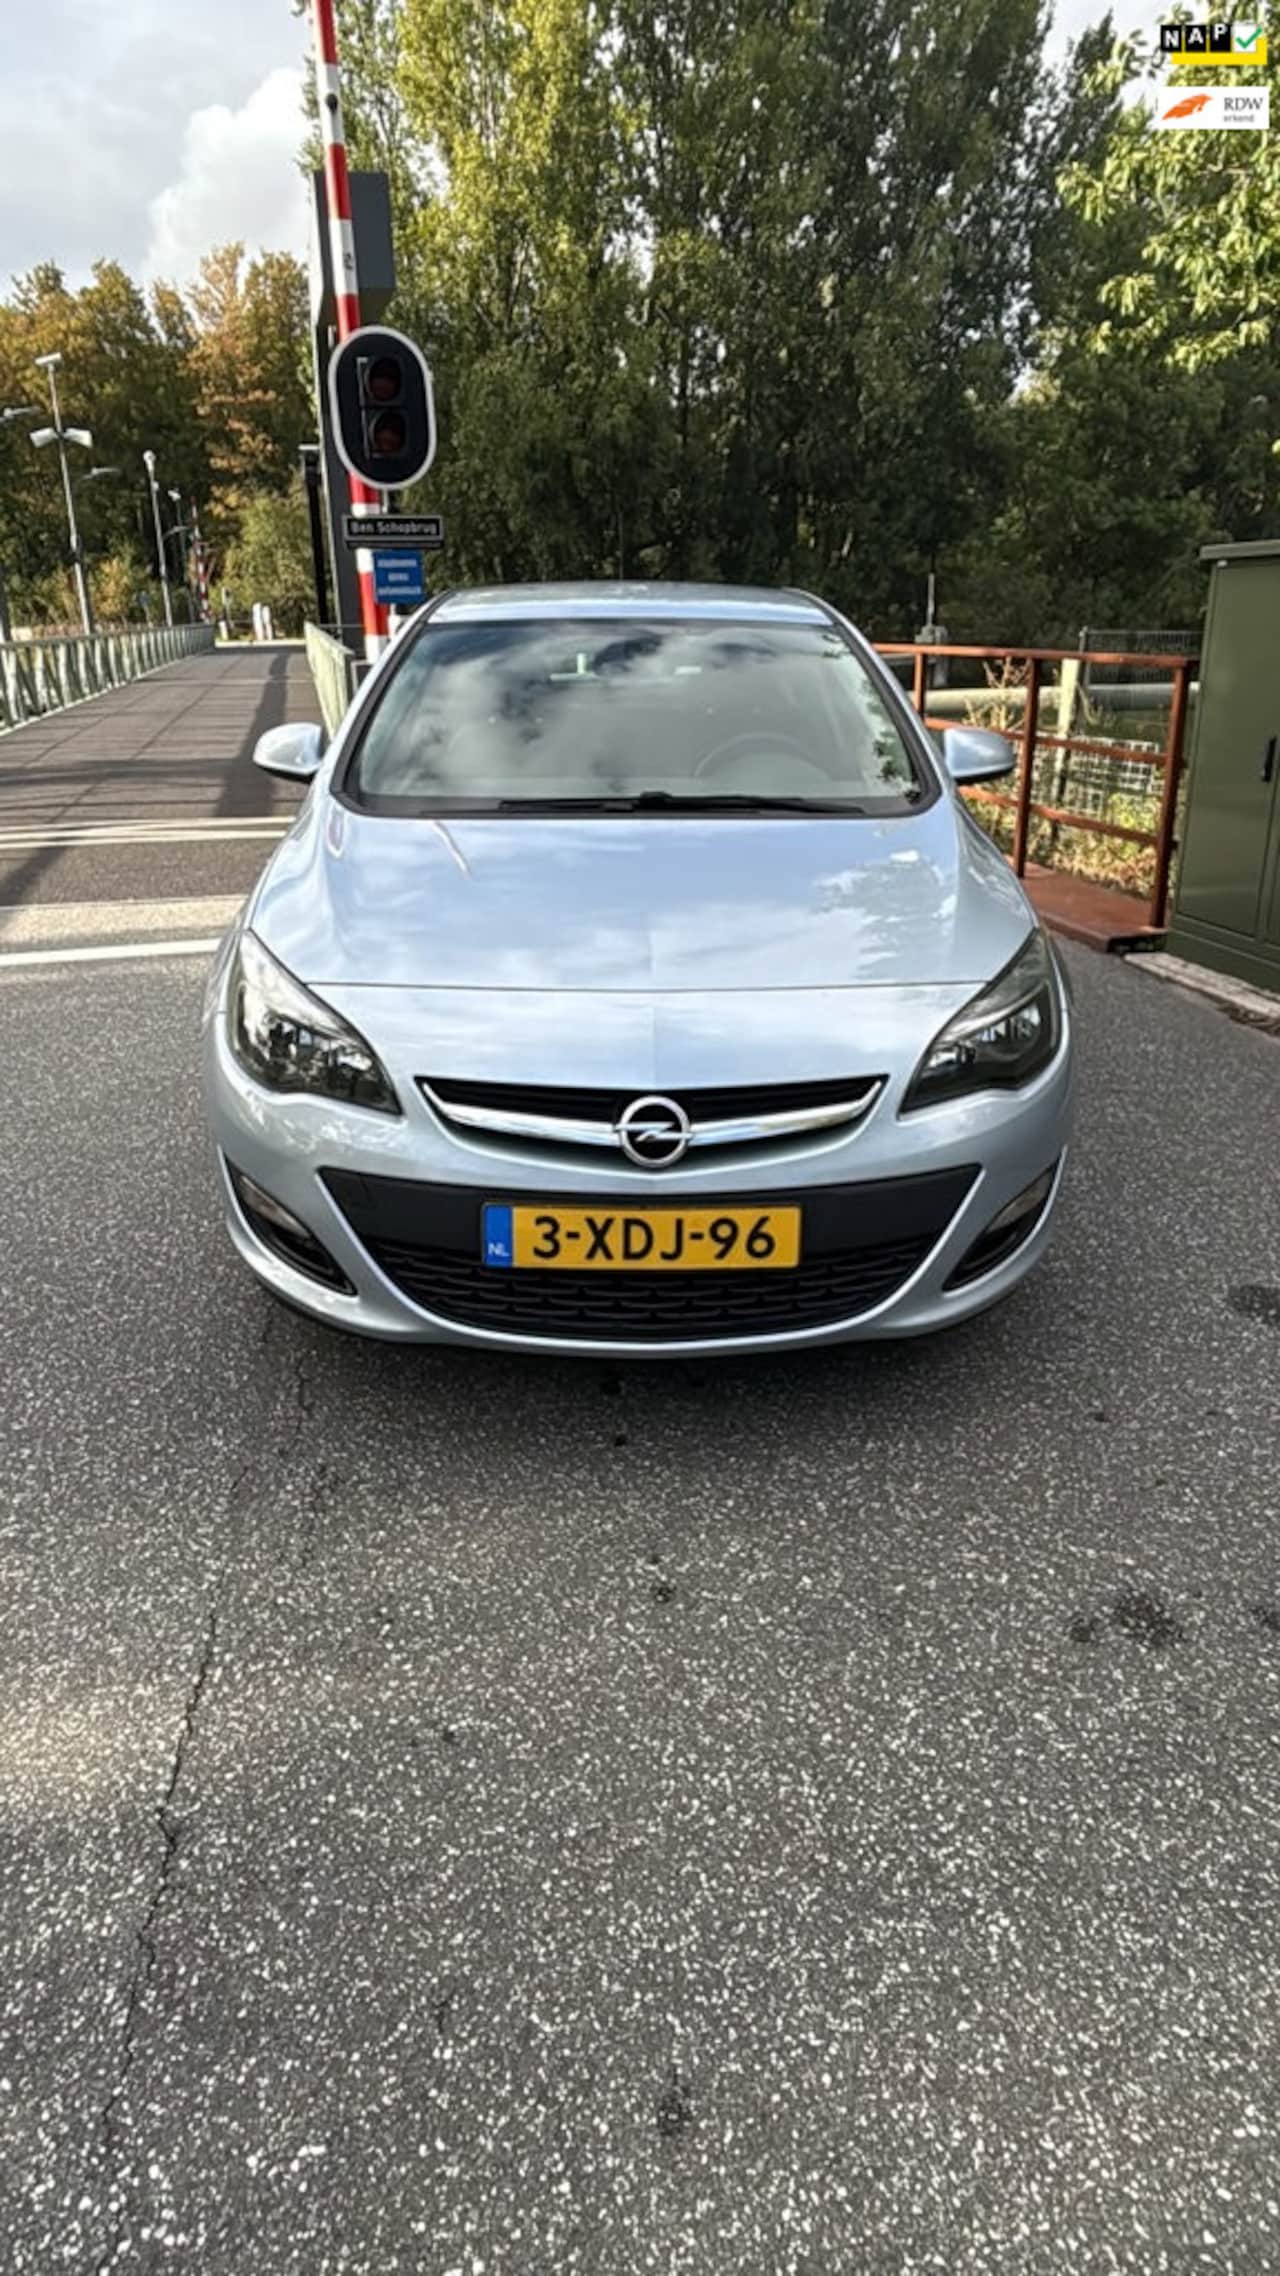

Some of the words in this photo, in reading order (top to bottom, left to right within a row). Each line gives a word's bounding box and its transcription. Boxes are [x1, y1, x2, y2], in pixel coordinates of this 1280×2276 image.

[351, 521, 374, 534] Ben
[532, 1215, 776, 1260] 3-XDJ-96
[488, 1244, 510, 1257] NL
